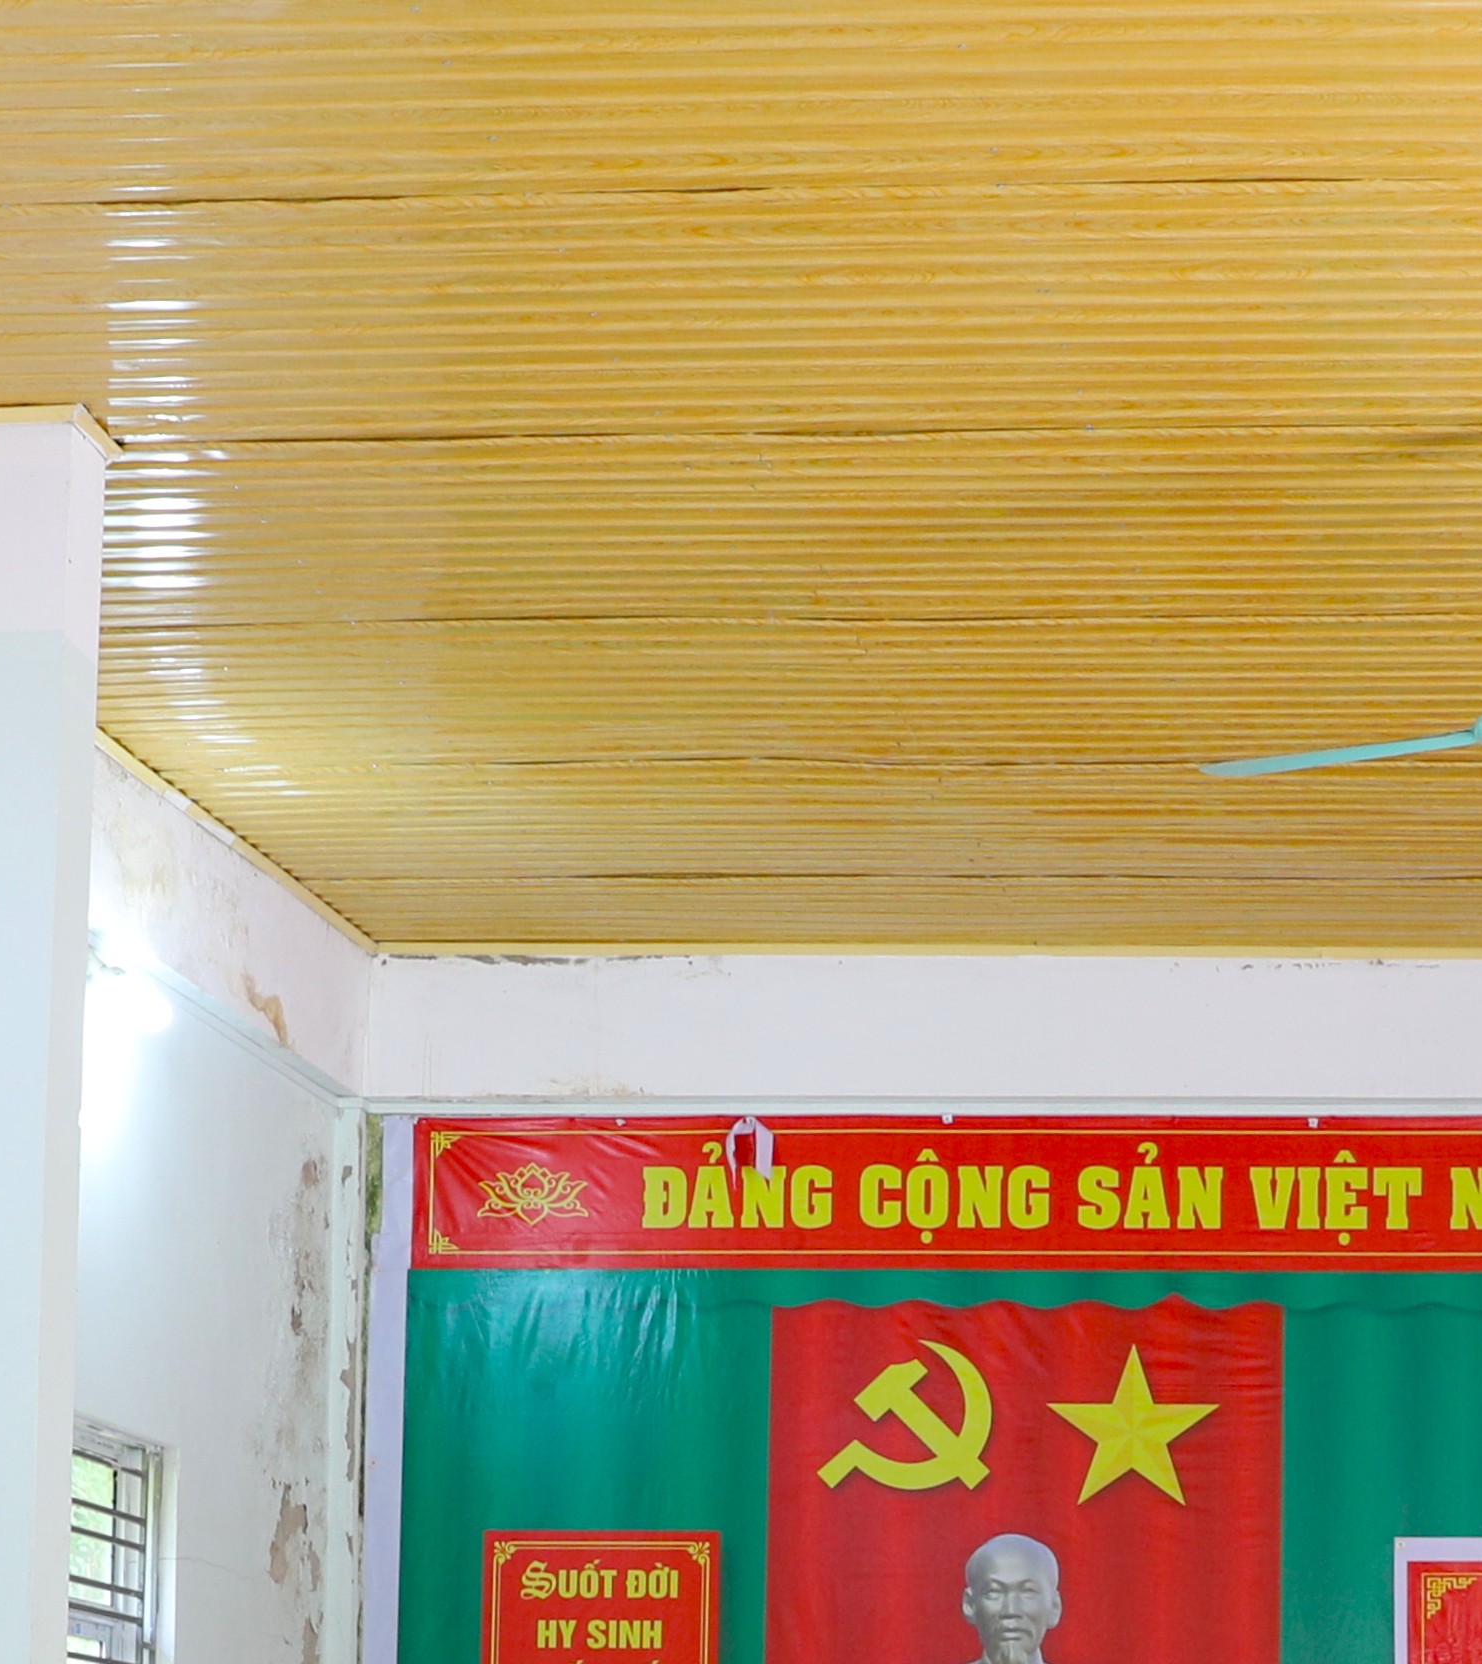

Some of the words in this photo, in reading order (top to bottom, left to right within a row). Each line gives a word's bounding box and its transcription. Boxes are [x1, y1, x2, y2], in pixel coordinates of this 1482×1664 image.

[642, 1142, 832, 1229] ĐẢNG
[860, 1149, 1050, 1244] CỘNG
[1078, 1142, 1223, 1229] SẢN
[1250, 1150, 1422, 1245] VIỆT
[521, 1560, 617, 1599] SUỐT
[626, 1563, 678, 1599] ĐỜI
[537, 1620, 577, 1648] HY
[587, 1620, 662, 1649] SINH
